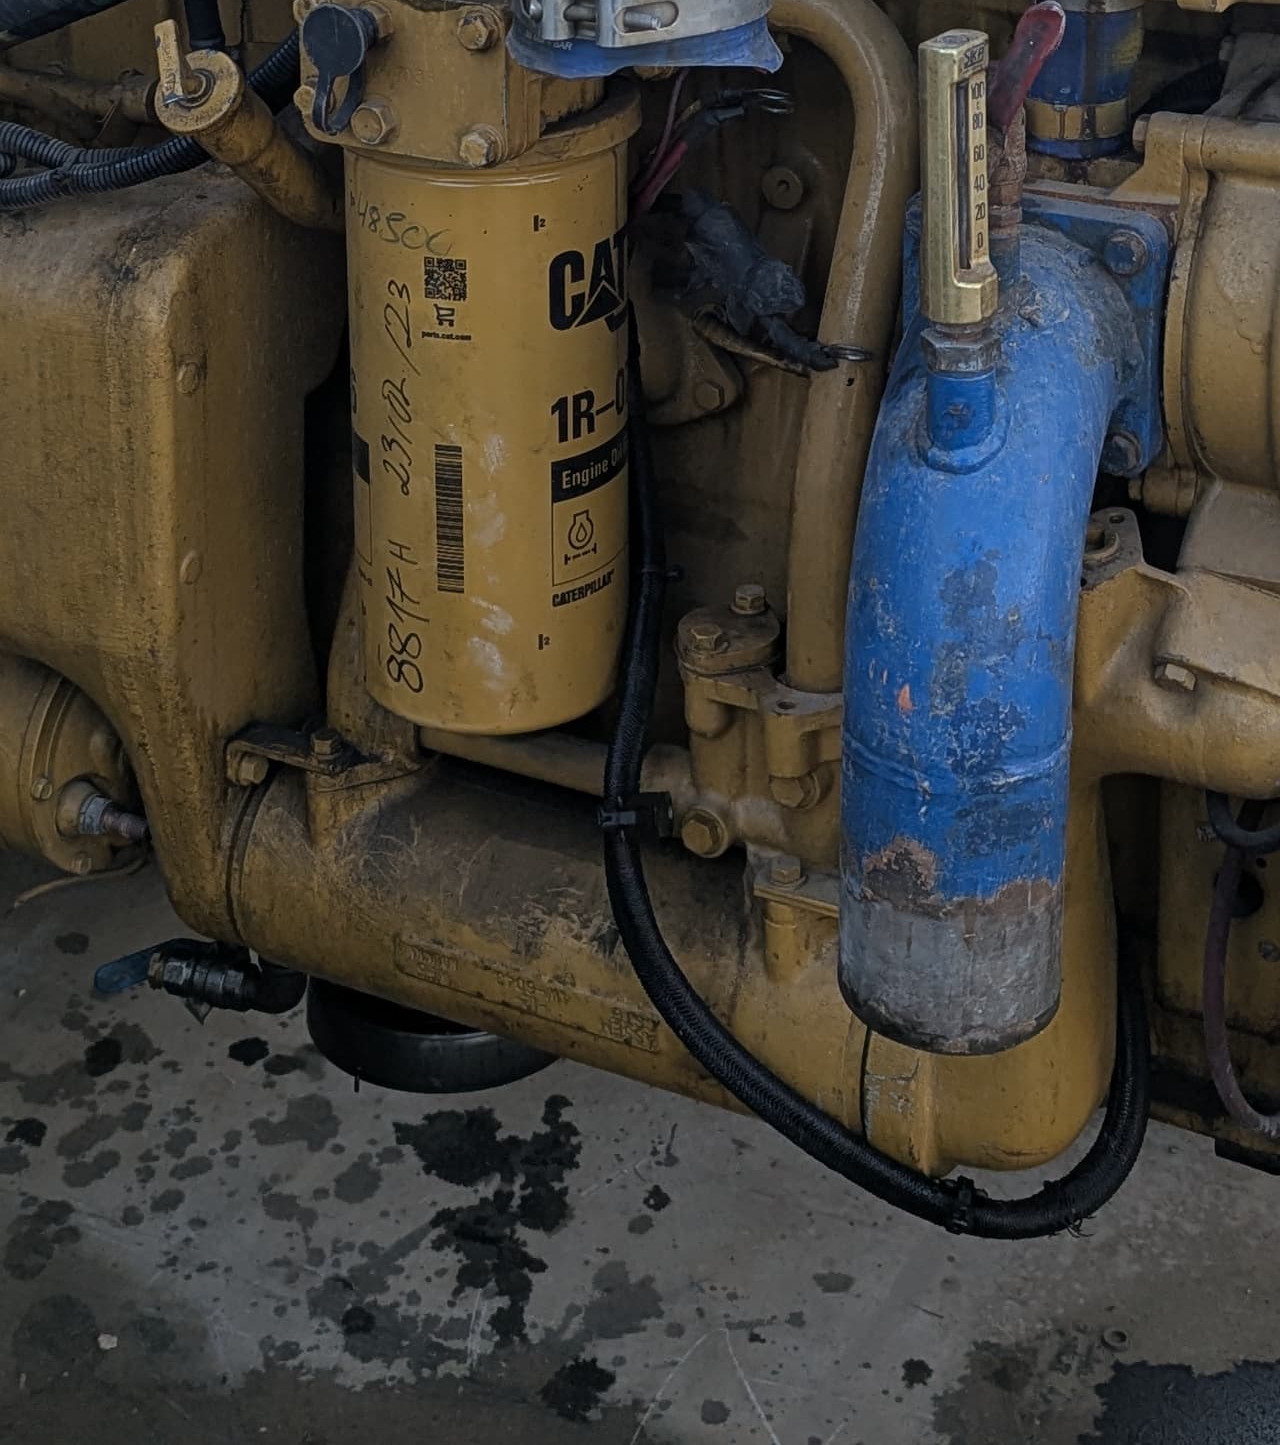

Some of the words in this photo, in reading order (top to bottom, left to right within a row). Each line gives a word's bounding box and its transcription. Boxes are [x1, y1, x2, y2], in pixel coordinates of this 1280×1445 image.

[970, 81, 985, 101] 100
[972, 112, 984, 131] 80
[973, 144, 985, 162] 60
[973, 173, 986, 192] 40
[975, 202, 986, 221] 20
[976, 231, 984, 250] 0
[561, 460, 610, 490] Engine
